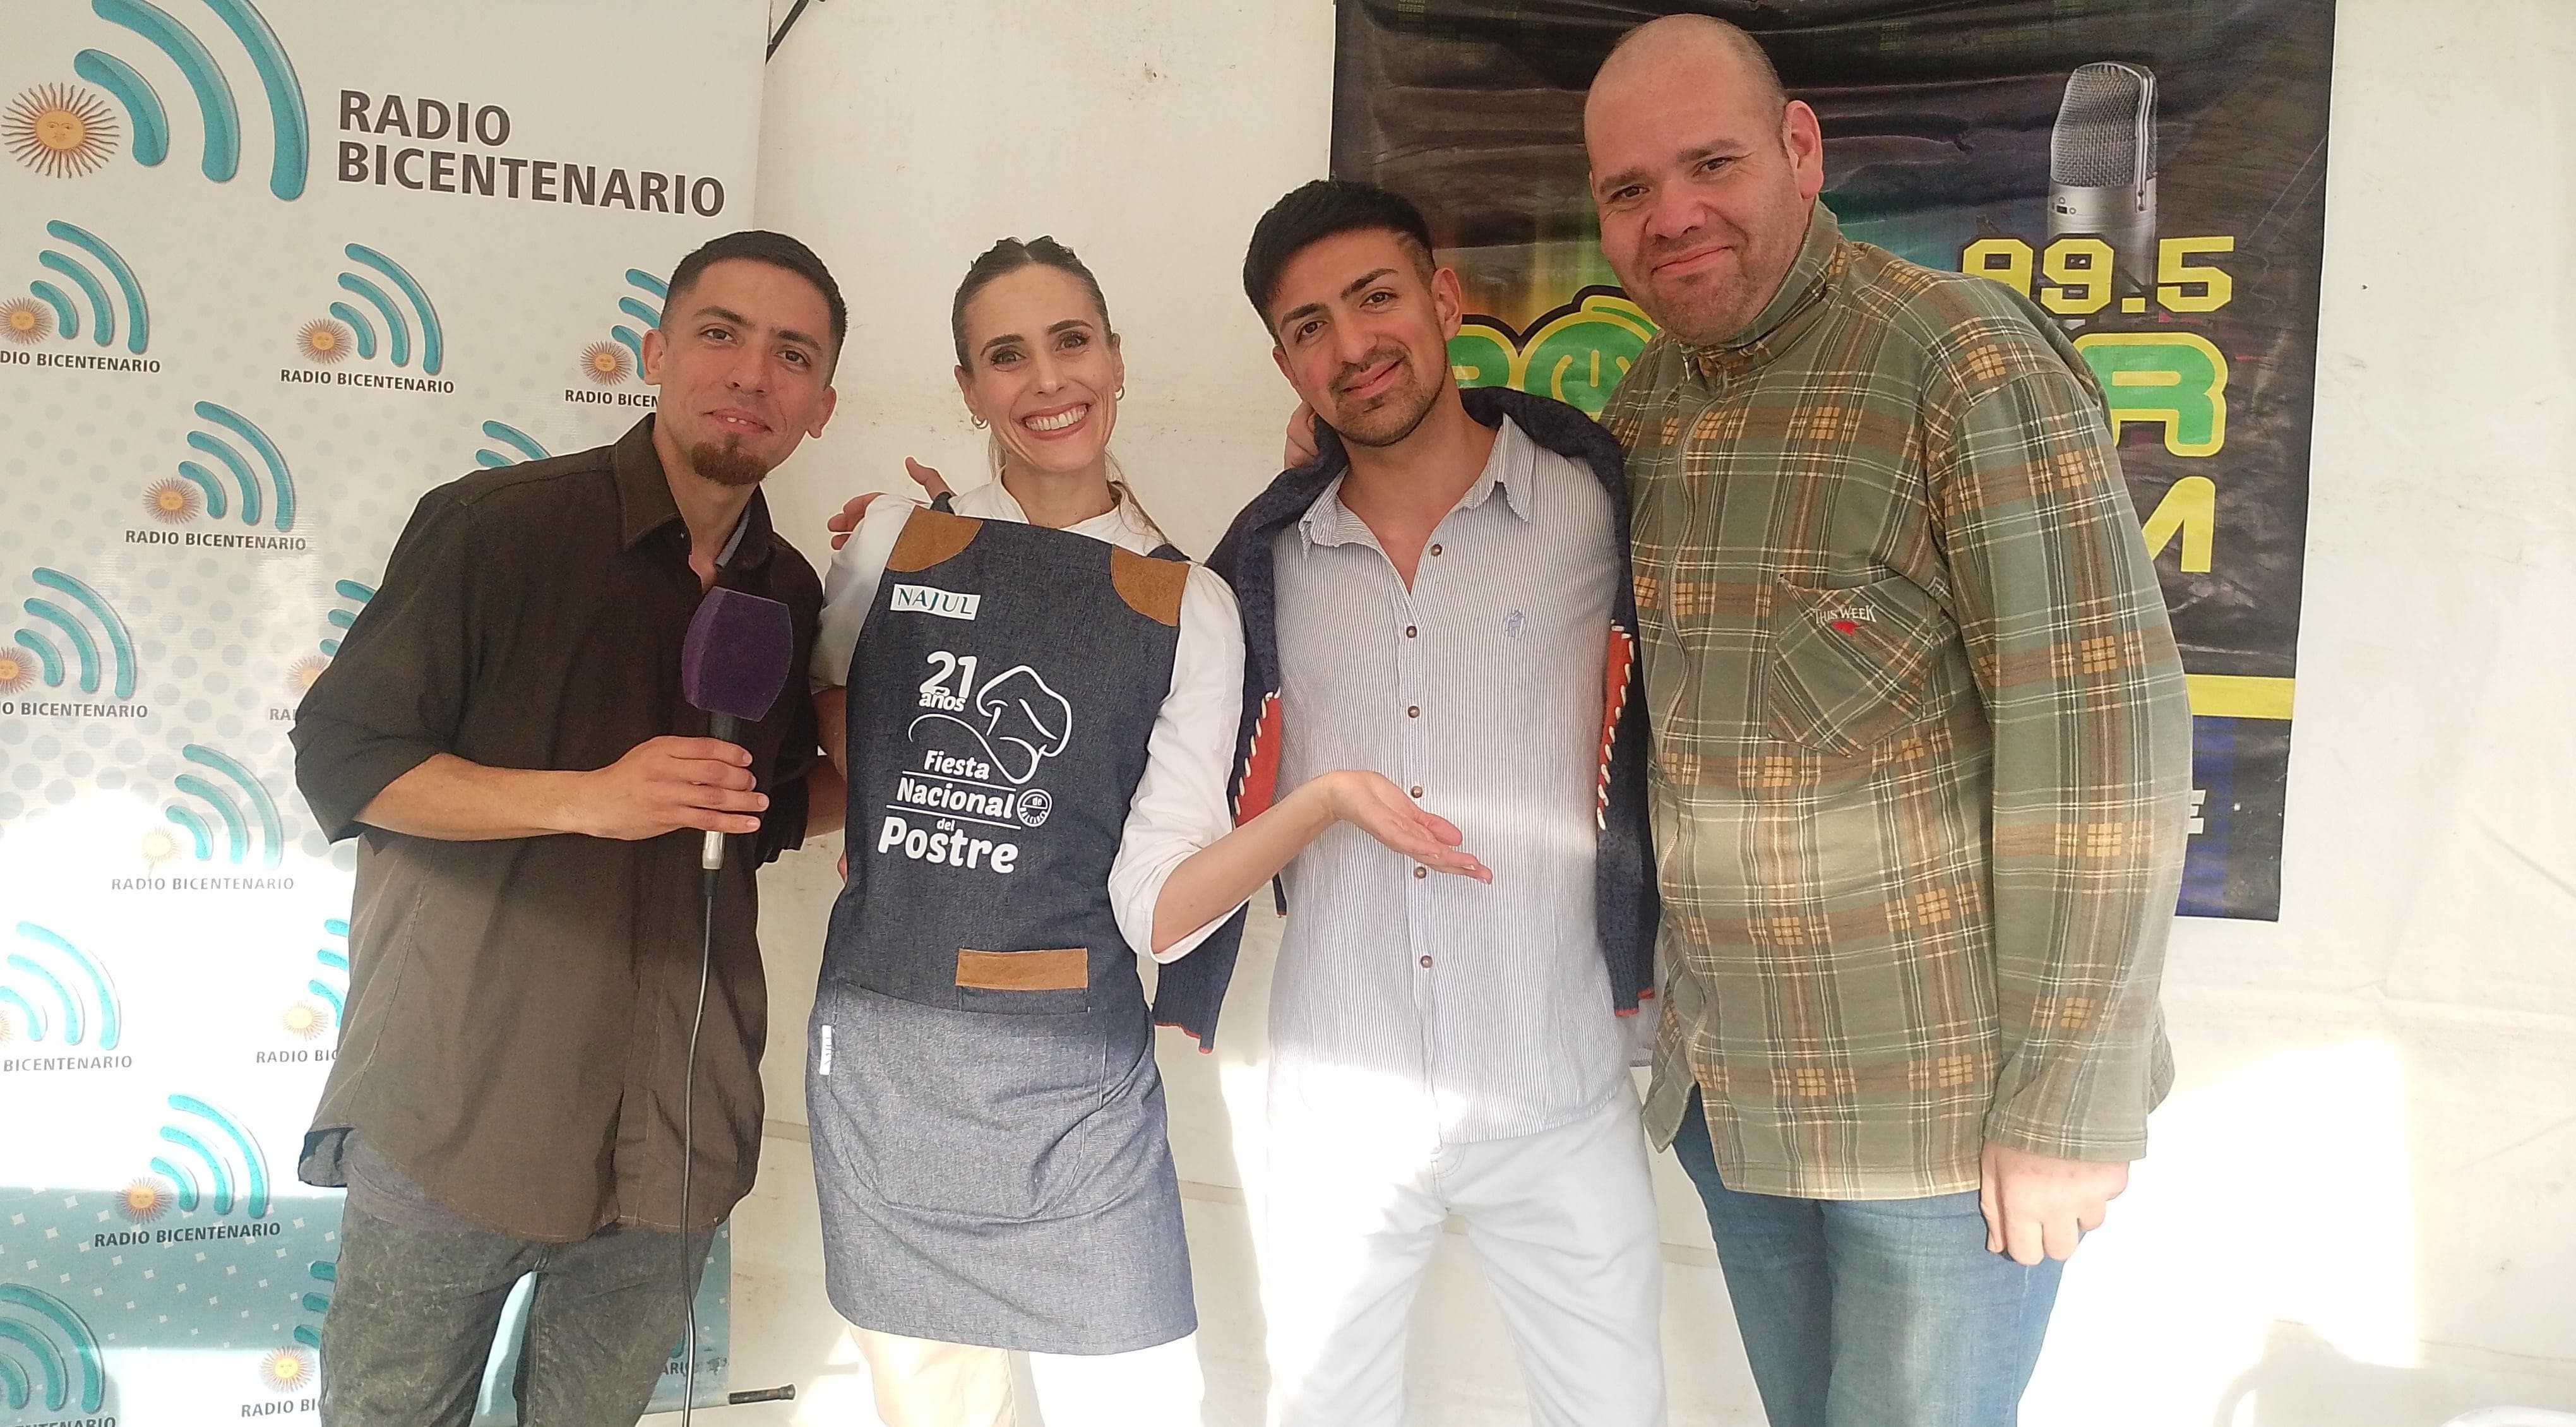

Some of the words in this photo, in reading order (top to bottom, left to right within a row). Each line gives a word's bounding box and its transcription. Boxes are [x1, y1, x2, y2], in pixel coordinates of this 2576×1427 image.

[338, 89, 510, 147] RADIO
[337, 140, 725, 218] BICENTENARIO
[1962, 236, 2234, 315] 99.5
[37, 353, 160, 373] BICENTENARIO
[281, 369, 331, 385] RADIO
[337, 373, 455, 394] BICENTENARIO
[565, 389, 612, 405] RADIO
[126, 530, 179, 546] RADIO
[185, 532, 306, 551] BICENTENARIO
[897, 587, 974, 616] NAJUL
[1811, 608, 1838, 624] THIS
[1839, 604, 1877, 623] WEEK
[919, 650, 977, 699] 21
[21, 702, 148, 718] BICENTENARIO
[919, 688, 967, 712] años
[923, 749, 990, 780] Fiesta
[896, 776, 1017, 819] Nacional
[936, 817, 955, 832] del
[877, 815, 1019, 874] Postre
[112, 878, 165, 891] RADIO
[172, 878, 294, 891] BICENTENARIO
[3, 1055, 133, 1072] BICENTENARIO
[256, 1050, 308, 1063] RADIO
[94, 1230, 150, 1248] RADIO
[156, 1222, 281, 1244] BICENTENARIO
[241, 1400, 294, 1418] RADIO
